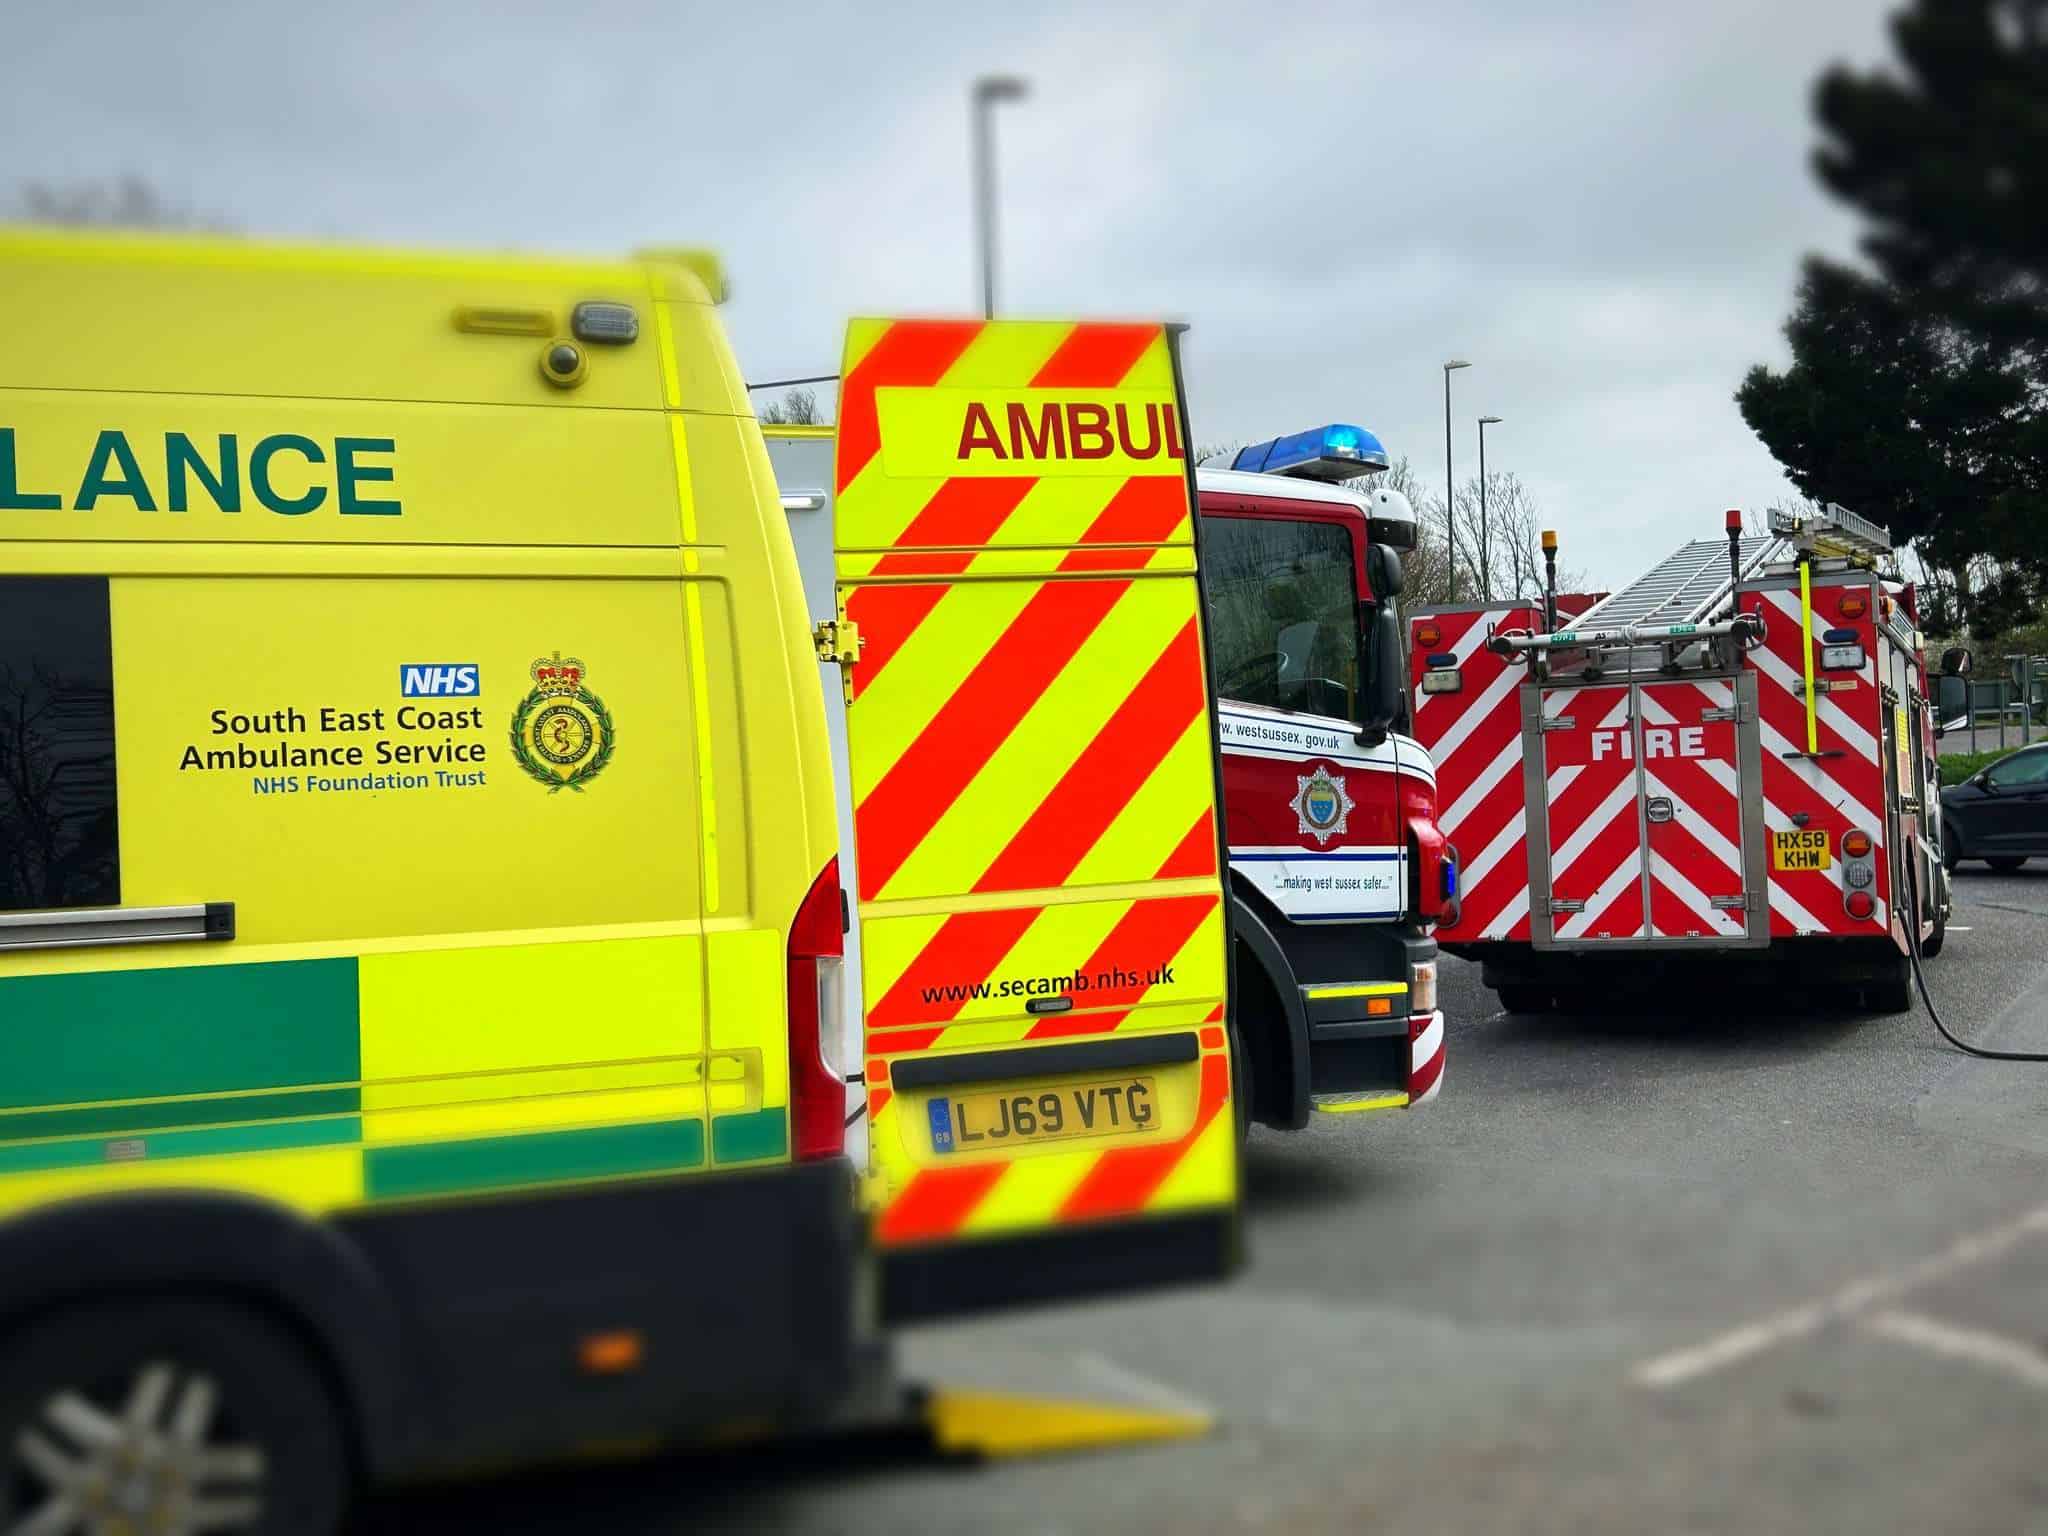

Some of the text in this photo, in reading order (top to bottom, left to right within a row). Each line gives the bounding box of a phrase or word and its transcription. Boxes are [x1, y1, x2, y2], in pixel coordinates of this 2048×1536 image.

[0, 427, 402, 516] LANCE
[403, 666, 476, 695] NHS
[211, 705, 482, 735] South East Coast
[179, 737, 486, 771] Ambulance Service
[1591, 726, 1705, 760] FIRE
[253, 769, 486, 795] NHS Foundation Trust
[1777, 831, 1825, 848] HX58
[1784, 850, 1819, 867] KHW
[1314, 876, 1332, 889] west
[1335, 879, 1361, 889] sussex
[922, 963, 1174, 1003] www.secamb.nhs.uk
[957, 1093, 1063, 1141] LJ69
[1073, 1083, 1151, 1128] VTG
